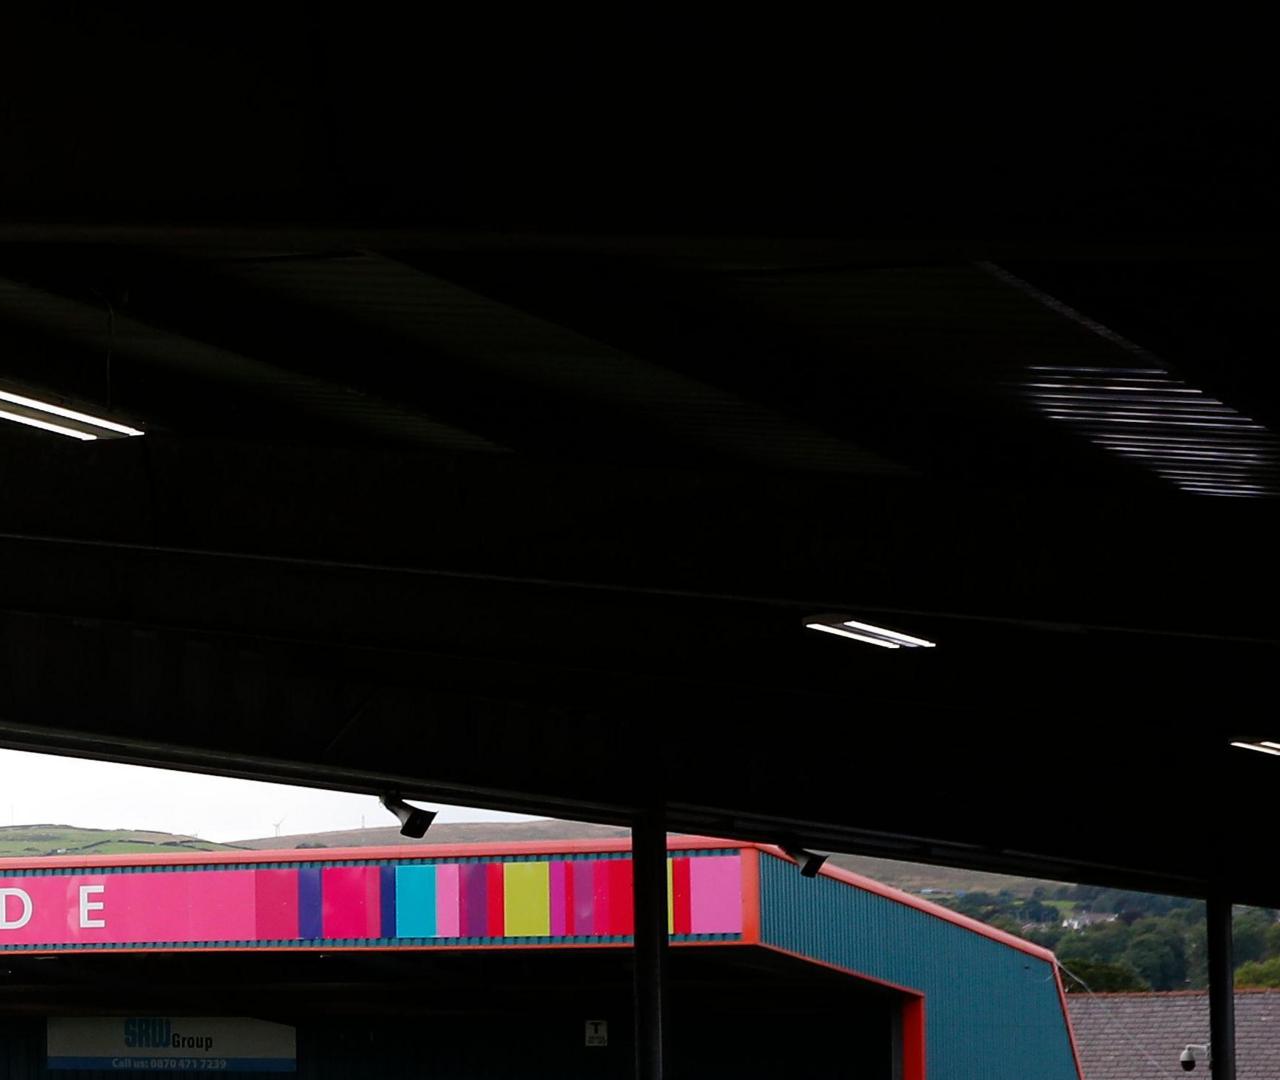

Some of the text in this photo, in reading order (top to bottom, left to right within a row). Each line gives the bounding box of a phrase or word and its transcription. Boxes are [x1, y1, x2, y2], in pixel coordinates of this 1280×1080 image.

[172, 1033, 214, 1052] Group
[111, 1058, 132, 1069] Call
[133, 1058, 149, 1069] us:
